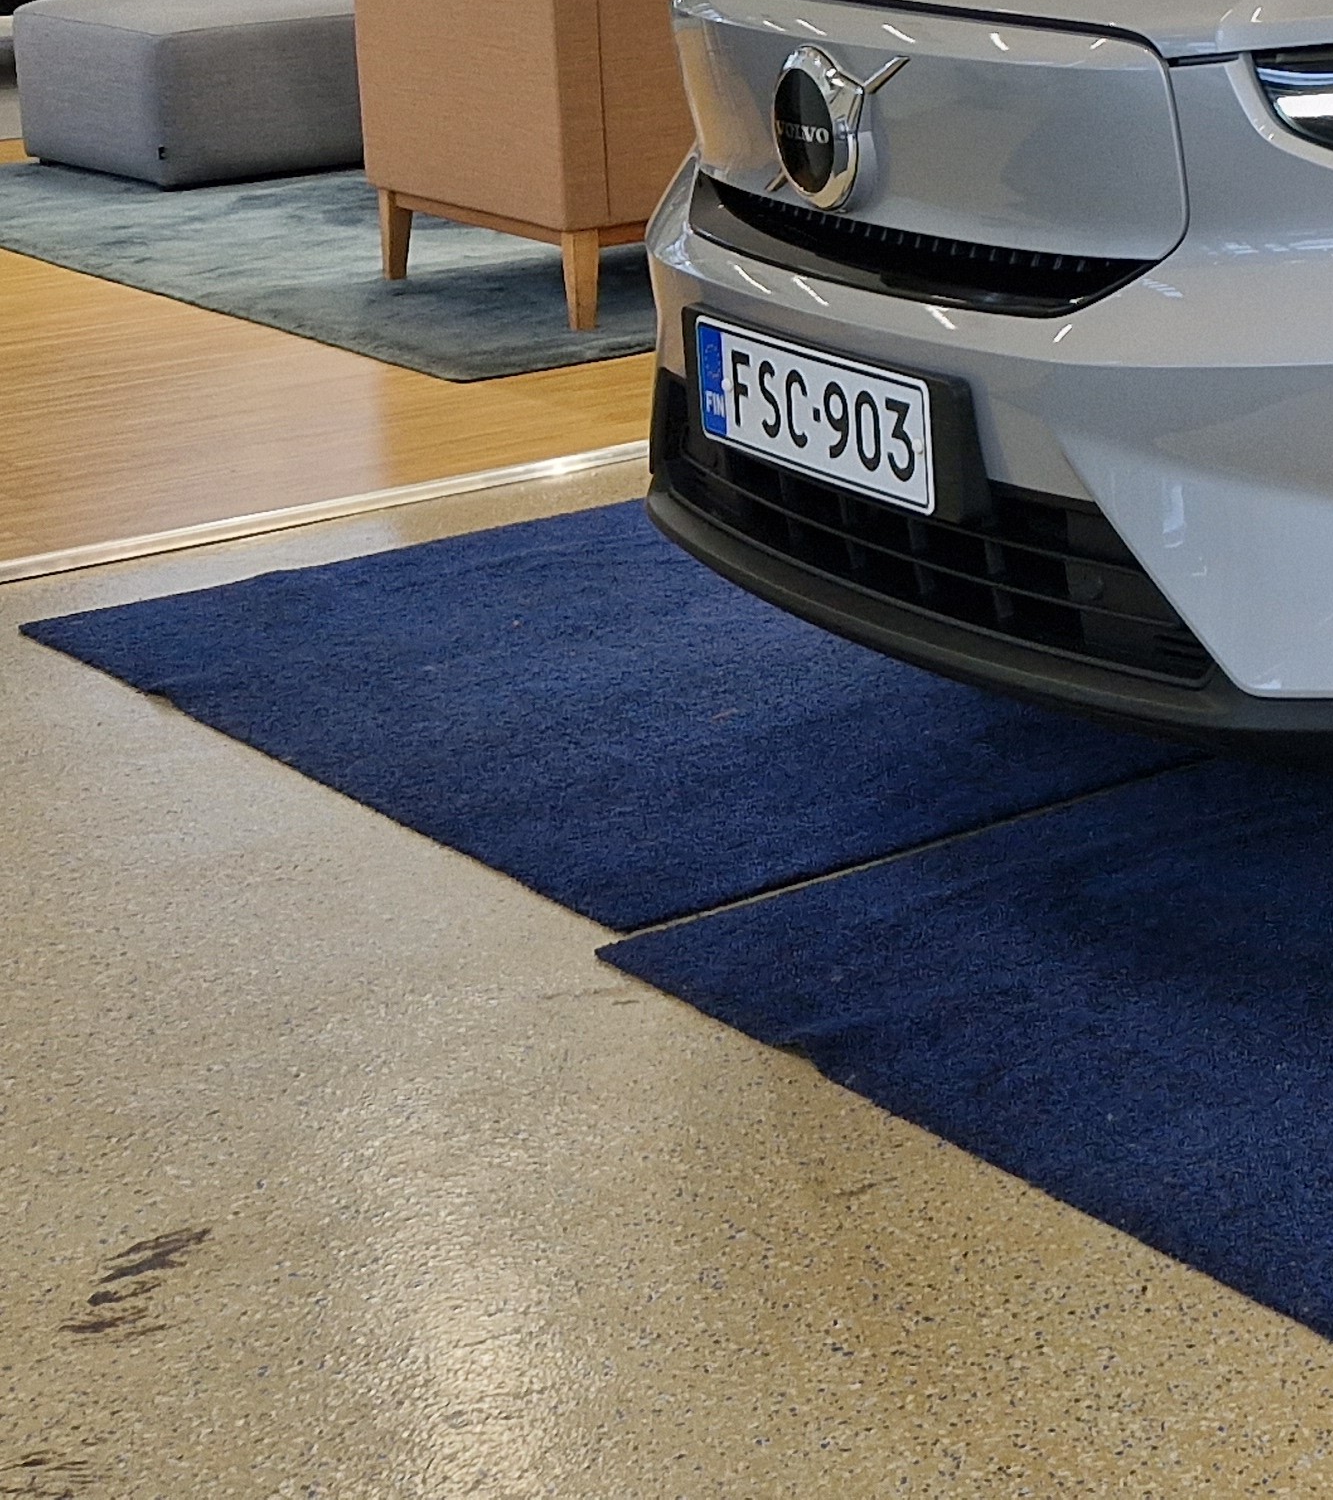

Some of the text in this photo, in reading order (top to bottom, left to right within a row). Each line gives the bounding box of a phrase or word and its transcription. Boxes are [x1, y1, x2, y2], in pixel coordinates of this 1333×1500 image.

[775, 120, 829, 143] VOLVO
[705, 390, 725, 418] FIN
[731, 349, 915, 482] FSC-903
